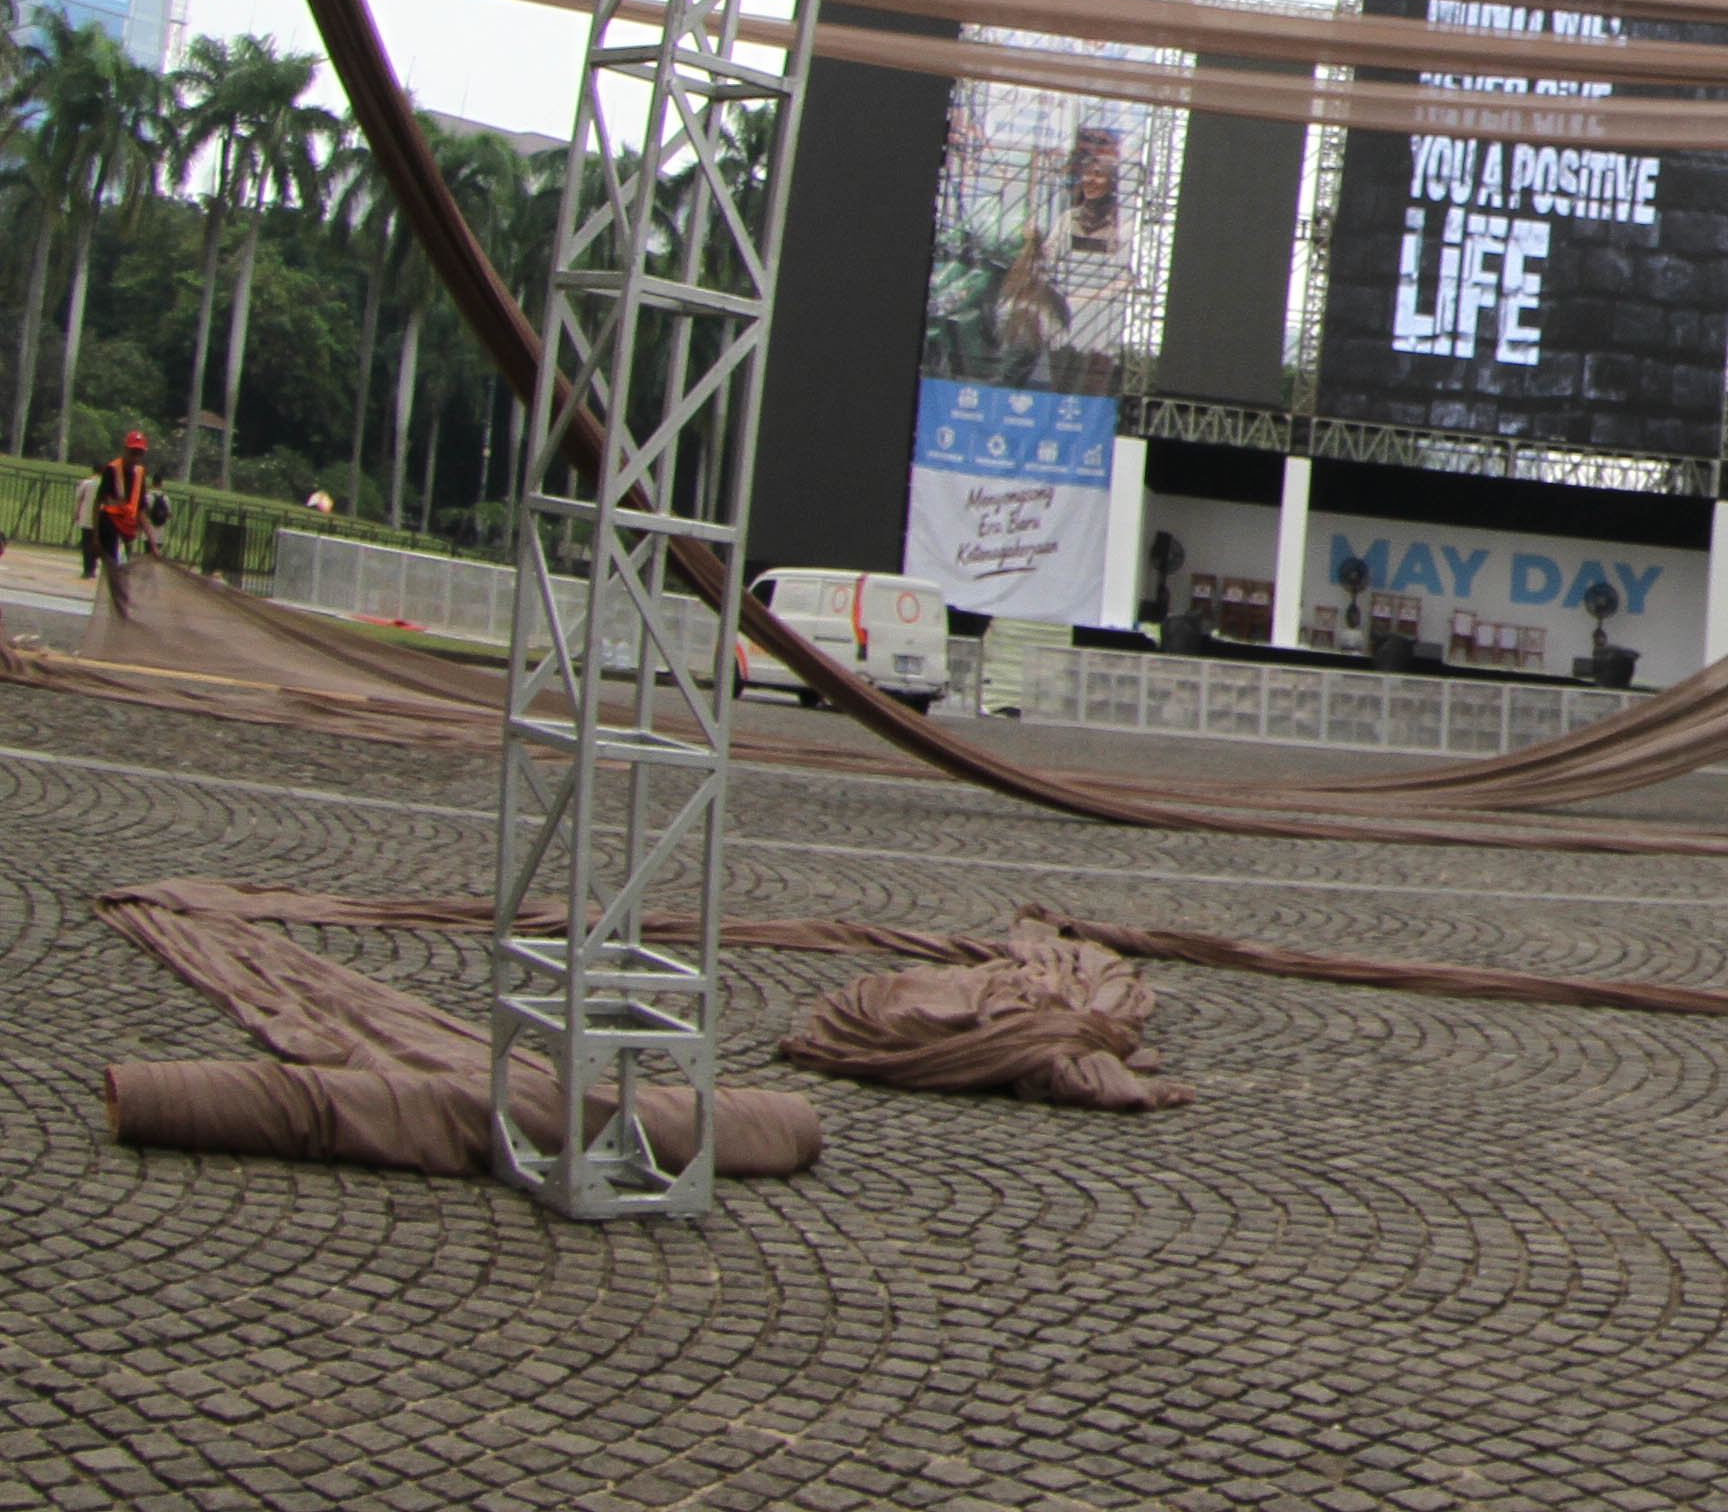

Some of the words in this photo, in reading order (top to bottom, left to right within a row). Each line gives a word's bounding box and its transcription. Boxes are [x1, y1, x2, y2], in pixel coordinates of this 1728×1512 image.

[1409, 134, 1478, 205] YOU
[1476, 141, 1504, 209] A
[1328, 533, 1491, 598] MAY
[1508, 552, 1665, 615] DAY
